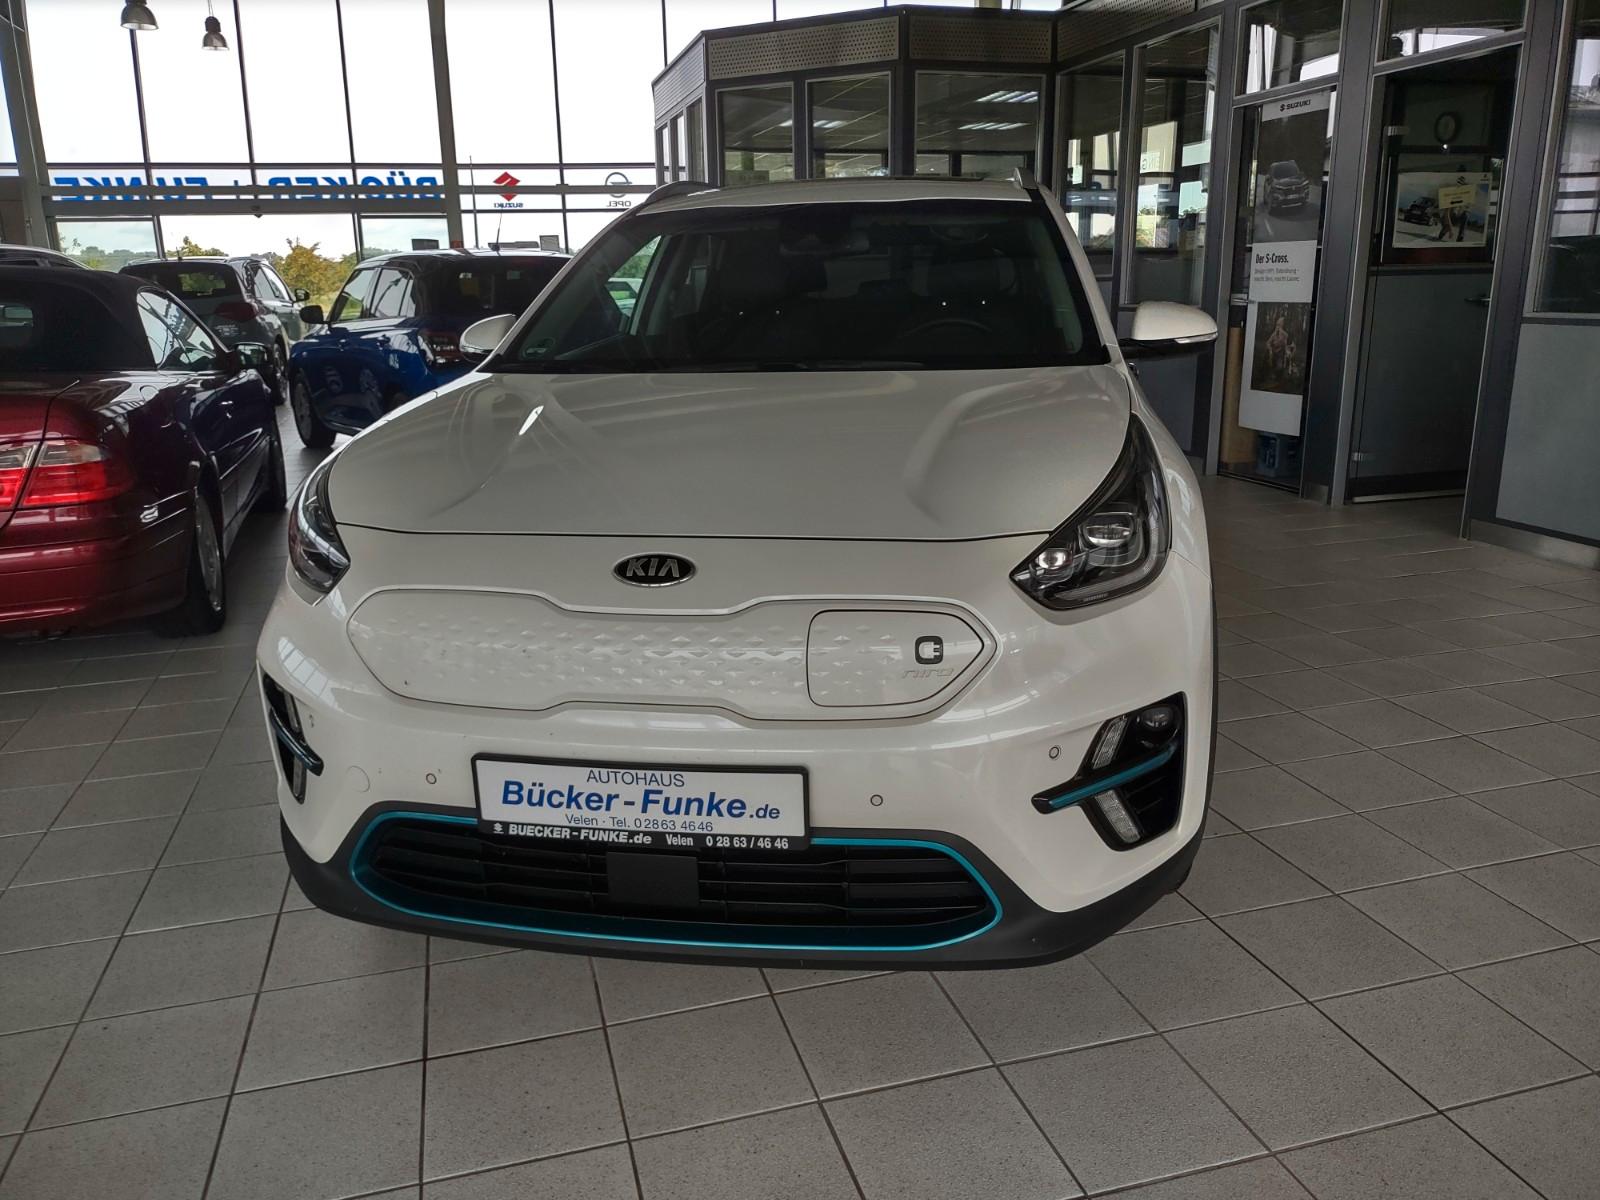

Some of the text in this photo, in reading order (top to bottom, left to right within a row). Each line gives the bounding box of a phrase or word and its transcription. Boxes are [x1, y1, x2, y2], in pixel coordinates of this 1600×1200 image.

[1286, 100, 1311, 110] SUZUKI
[626, 558, 680, 578] KIA
[586, 769, 685, 787] AUTOHAUS
[565, 813, 713, 832] Velen Tel. 02863 4646
[665, 833, 694, 846] Velen
[705, 835, 713, 847] 0
[716, 836, 730, 847] 28
[733, 837, 747, 848] 63
[757, 838, 772, 848] 46
[774, 838, 789, 849] 46
